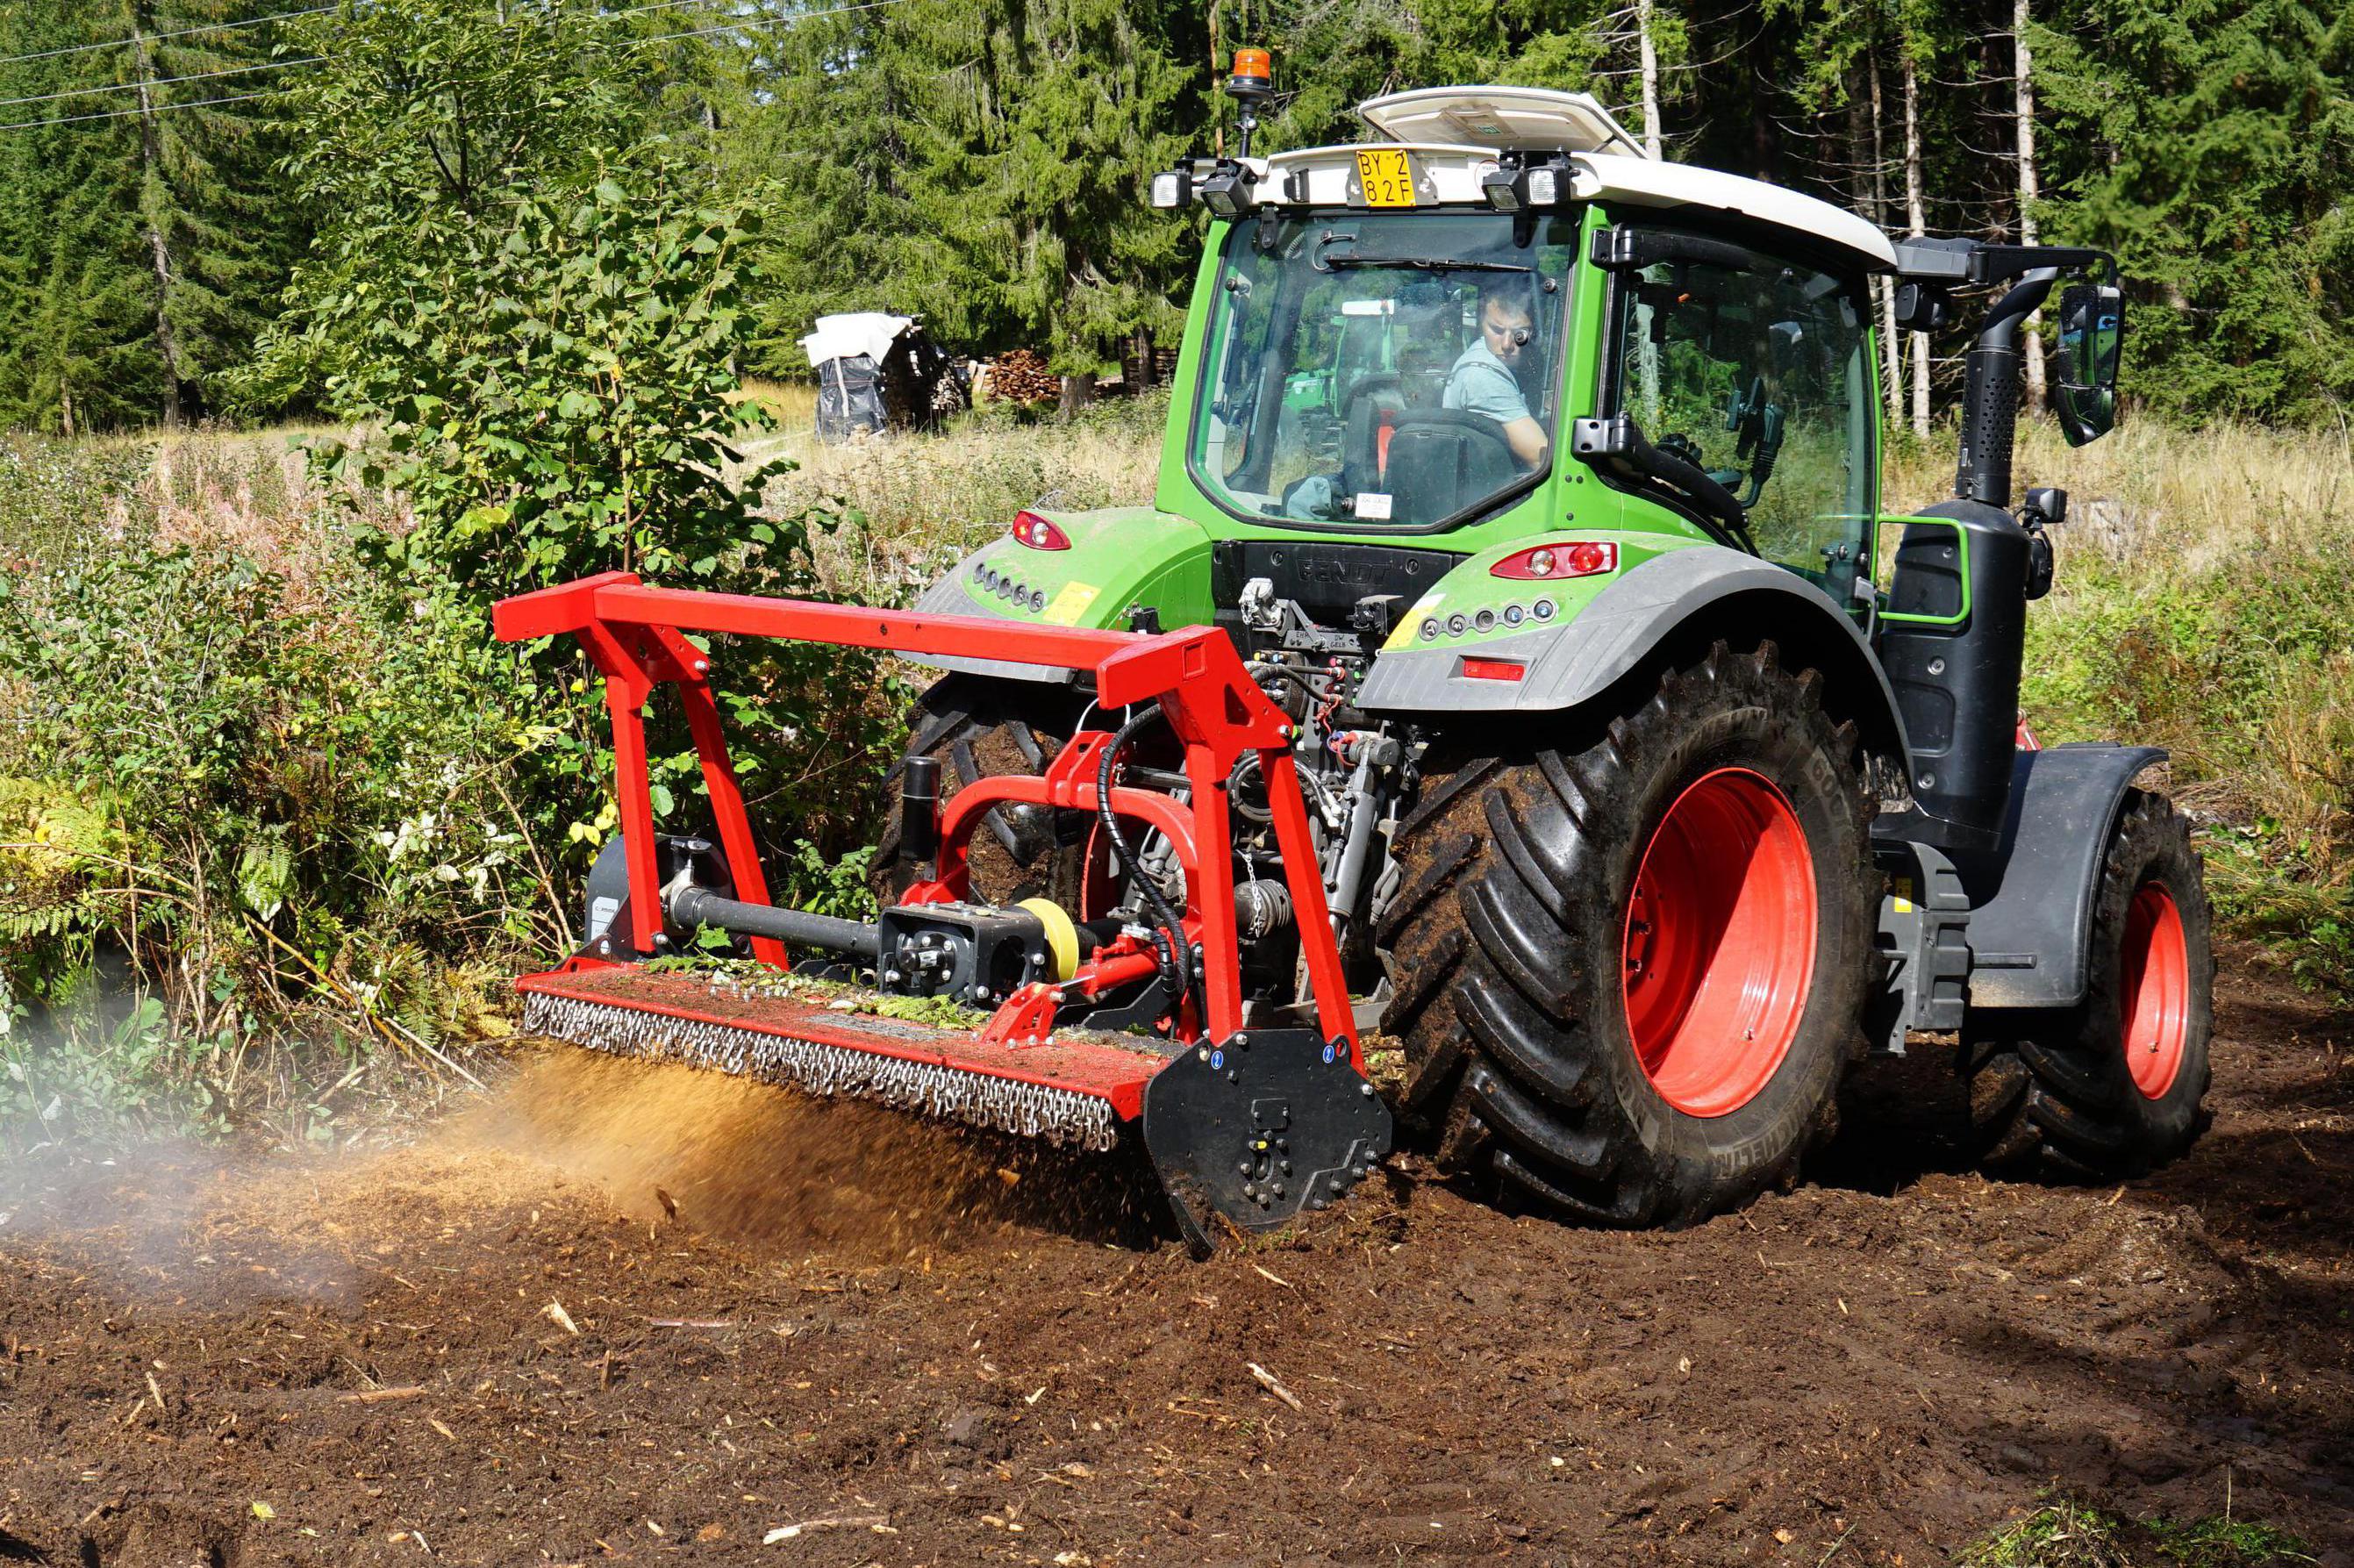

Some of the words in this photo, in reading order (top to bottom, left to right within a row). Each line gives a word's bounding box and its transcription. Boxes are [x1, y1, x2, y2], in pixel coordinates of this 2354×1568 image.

[1358, 153, 1381, 175] BY
[1395, 153, 1407, 175] 2
[1365, 179, 1410, 202] 82F
[1297, 558, 1392, 586] FENDT
